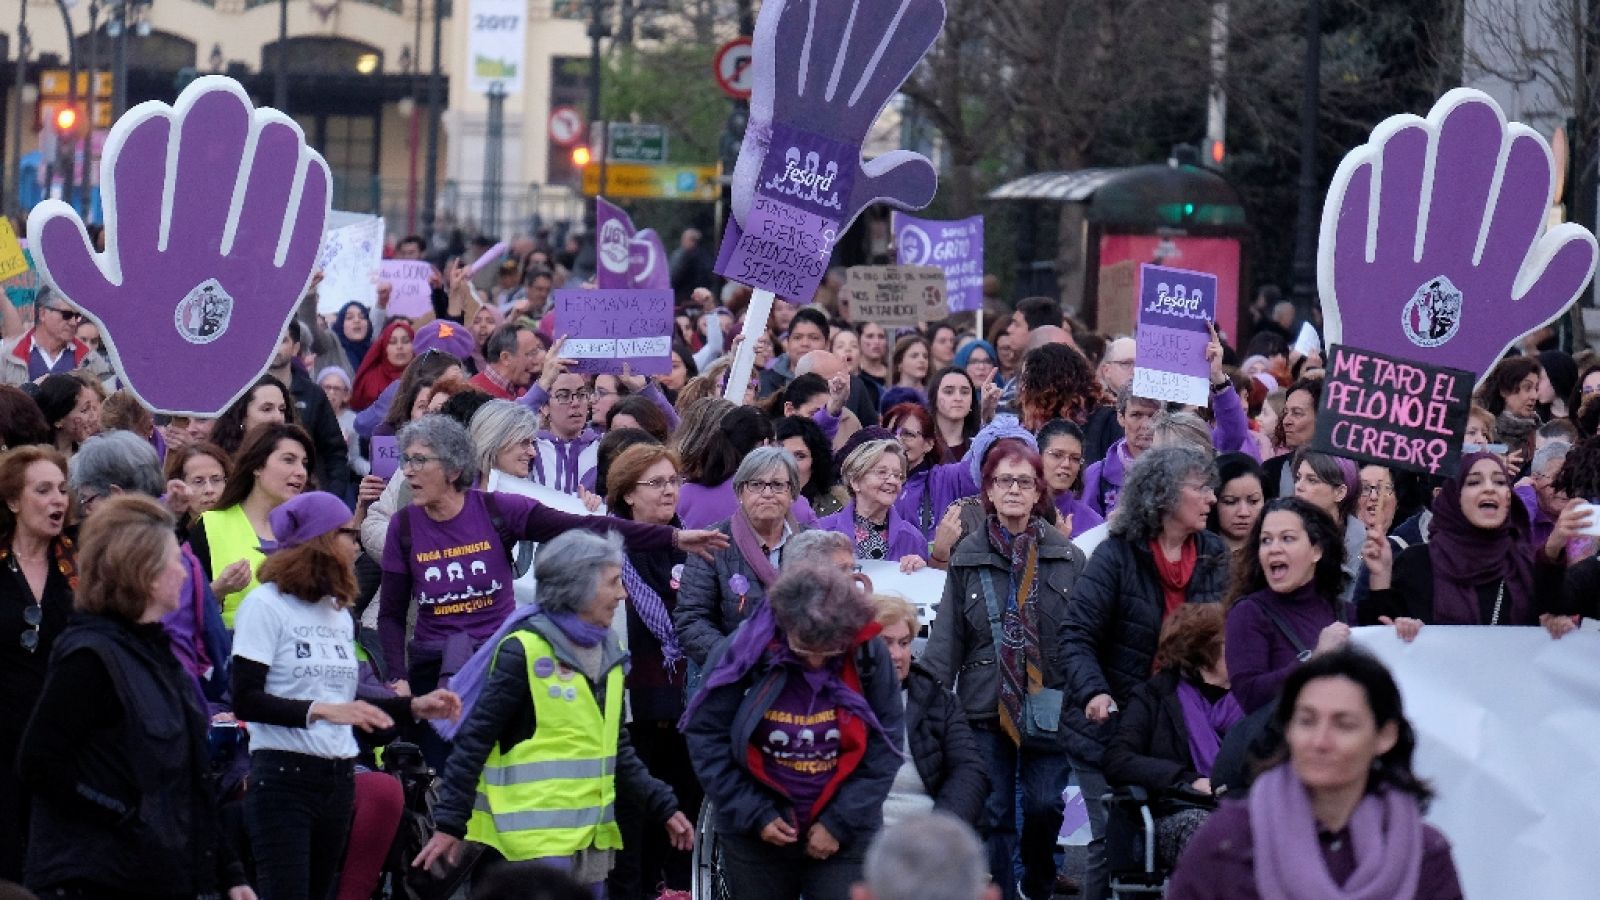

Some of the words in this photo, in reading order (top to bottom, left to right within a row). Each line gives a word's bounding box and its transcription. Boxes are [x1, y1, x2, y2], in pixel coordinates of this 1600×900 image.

[474, 15, 519, 31] 2017
[780, 161, 836, 191] fesord
[818, 219, 828, 232] Y
[740, 233, 823, 277] FEMINISTAS
[933, 239, 970, 261] GRITO
[737, 257, 804, 296] SIEMPRE
[648, 297, 666, 313] YO
[1156, 290, 1200, 310] fesord
[600, 318, 621, 335] TE
[629, 318, 666, 335] CREO
[619, 339, 667, 354] VIVAS
[1333, 349, 1369, 384] ME
[1372, 358, 1427, 395] TAPO
[1431, 373, 1460, 402] EL
[1327, 381, 1387, 419] PELO
[1389, 394, 1424, 427] NO
[1425, 401, 1454, 435] EL
[443, 540, 491, 558] FEMINISTA
[292, 664, 323, 679] CASI
